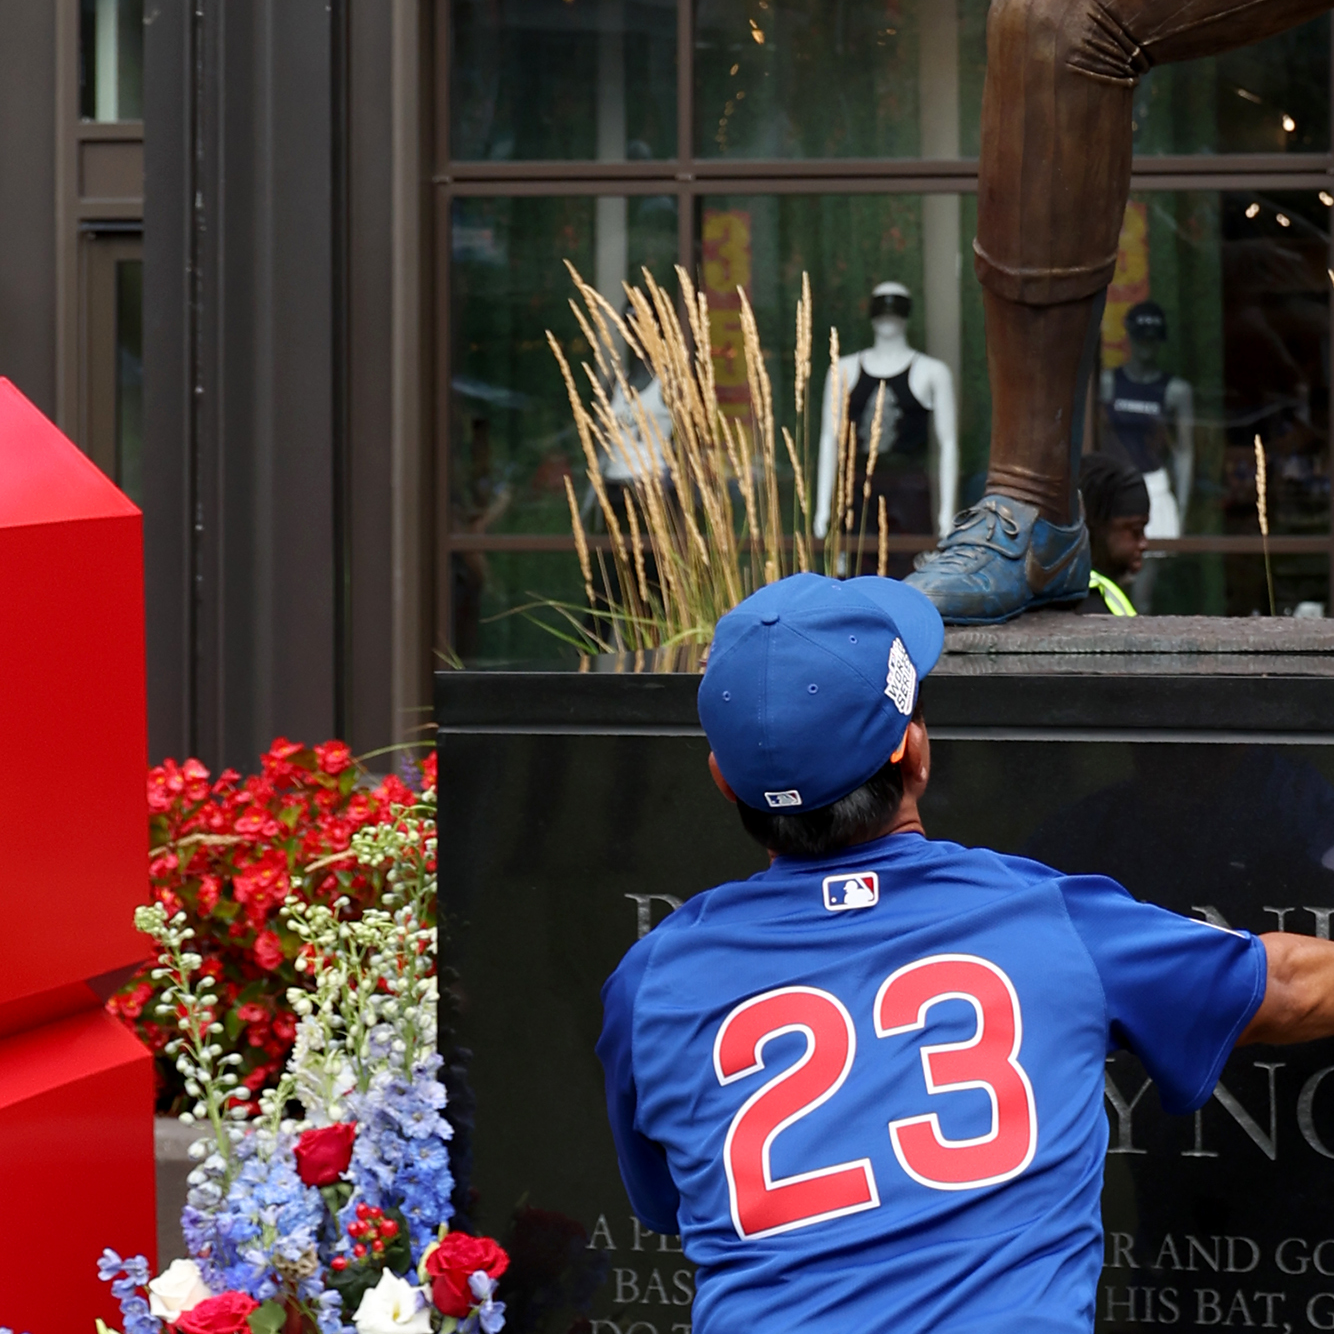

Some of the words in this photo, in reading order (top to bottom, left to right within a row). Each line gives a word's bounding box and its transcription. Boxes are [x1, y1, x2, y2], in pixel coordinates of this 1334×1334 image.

[712, 953, 1038, 1241] 23
[585, 1213, 617, 1250] A
[1154, 1233, 1261, 1274] AND
[1104, 1286, 1181, 1325] HIS
